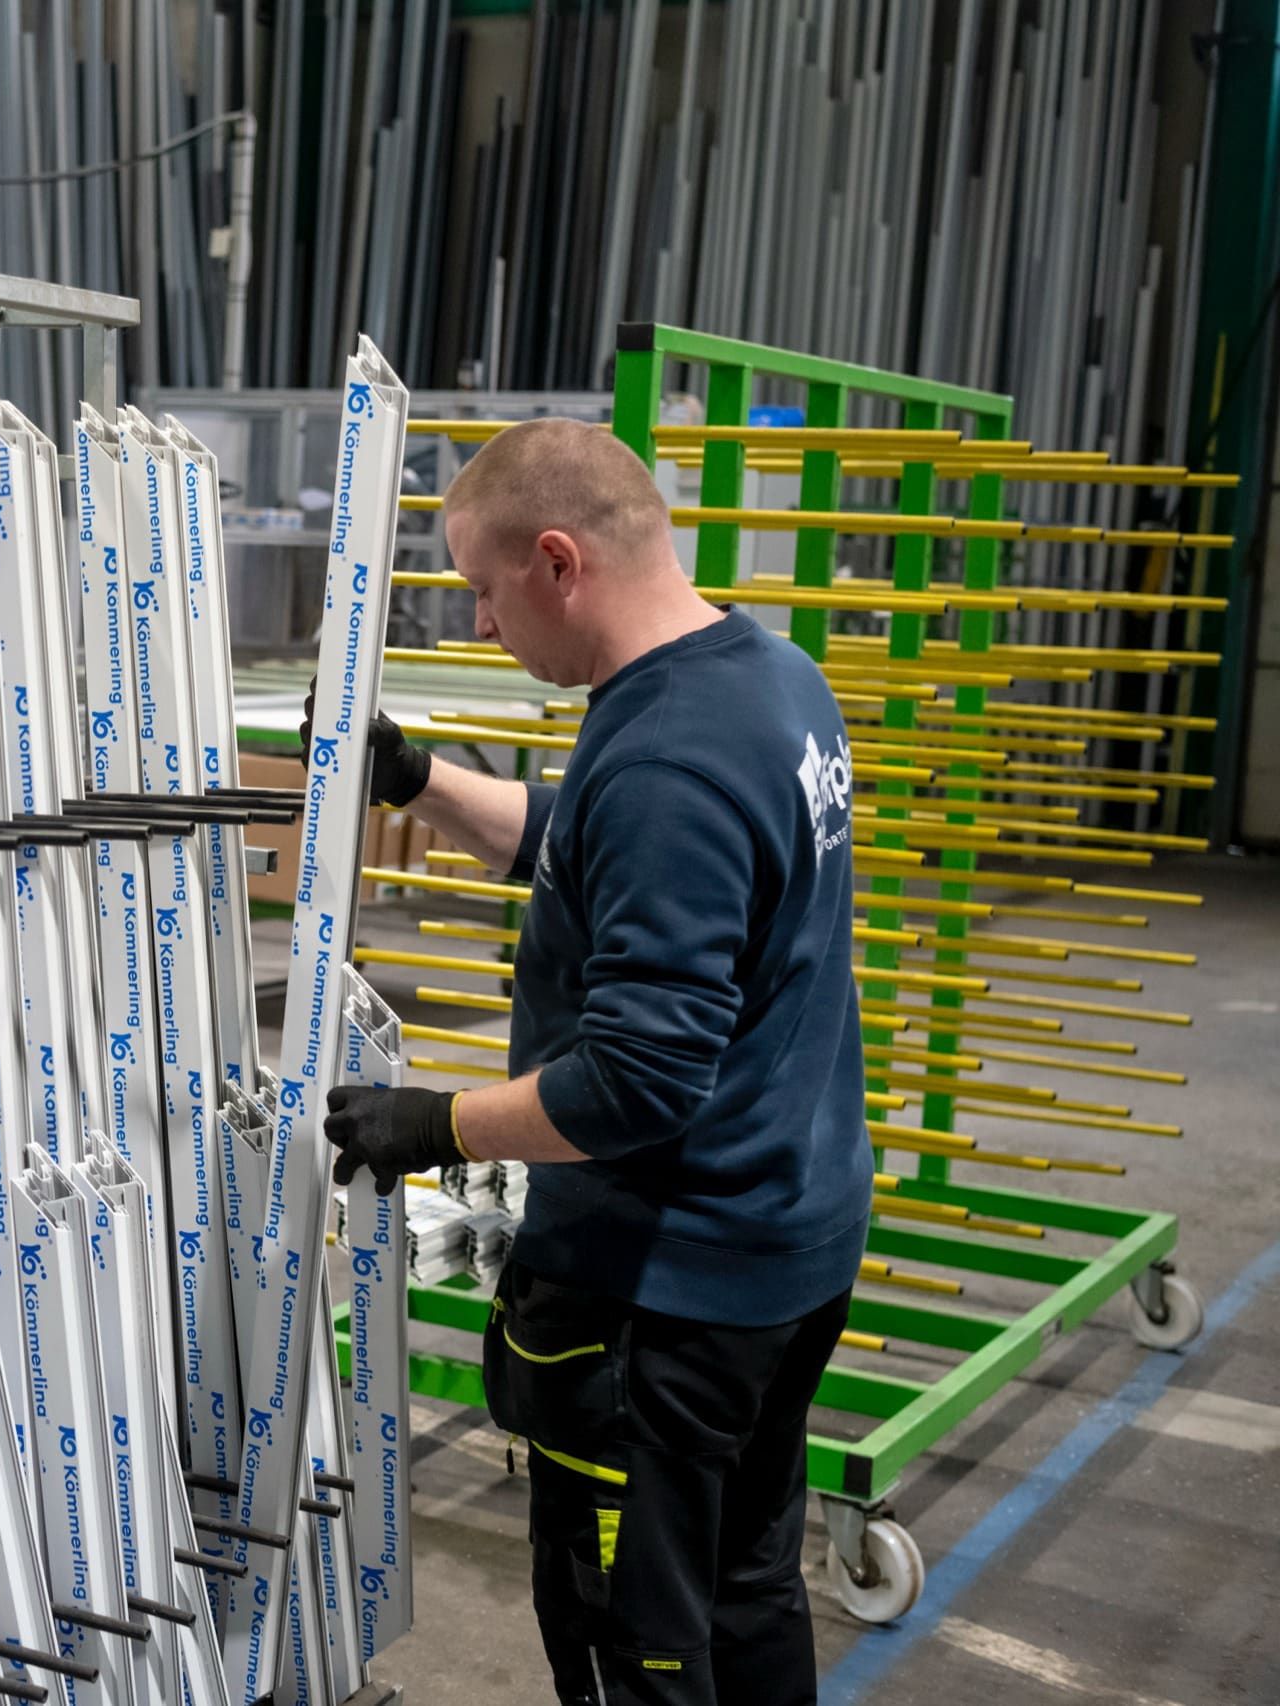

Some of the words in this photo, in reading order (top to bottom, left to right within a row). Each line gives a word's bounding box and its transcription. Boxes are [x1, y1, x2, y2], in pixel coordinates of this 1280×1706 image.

[184, 462, 205, 583] Kömmerling
[331, 421, 361, 556] Kömmerling
[136, 616, 158, 741] Kömmerling
[297, 774, 326, 904] Kömmerling
[159, 942, 181, 1064] Kömmerling
[264, 1114, 294, 1239] Kömmerling
[182, 1265, 204, 1385] Kömmerling
[353, 1281, 373, 1405] Kömmerling
[63, 1465, 89, 1600] Kömmerling
[380, 1447, 399, 1567] Kömmerling
